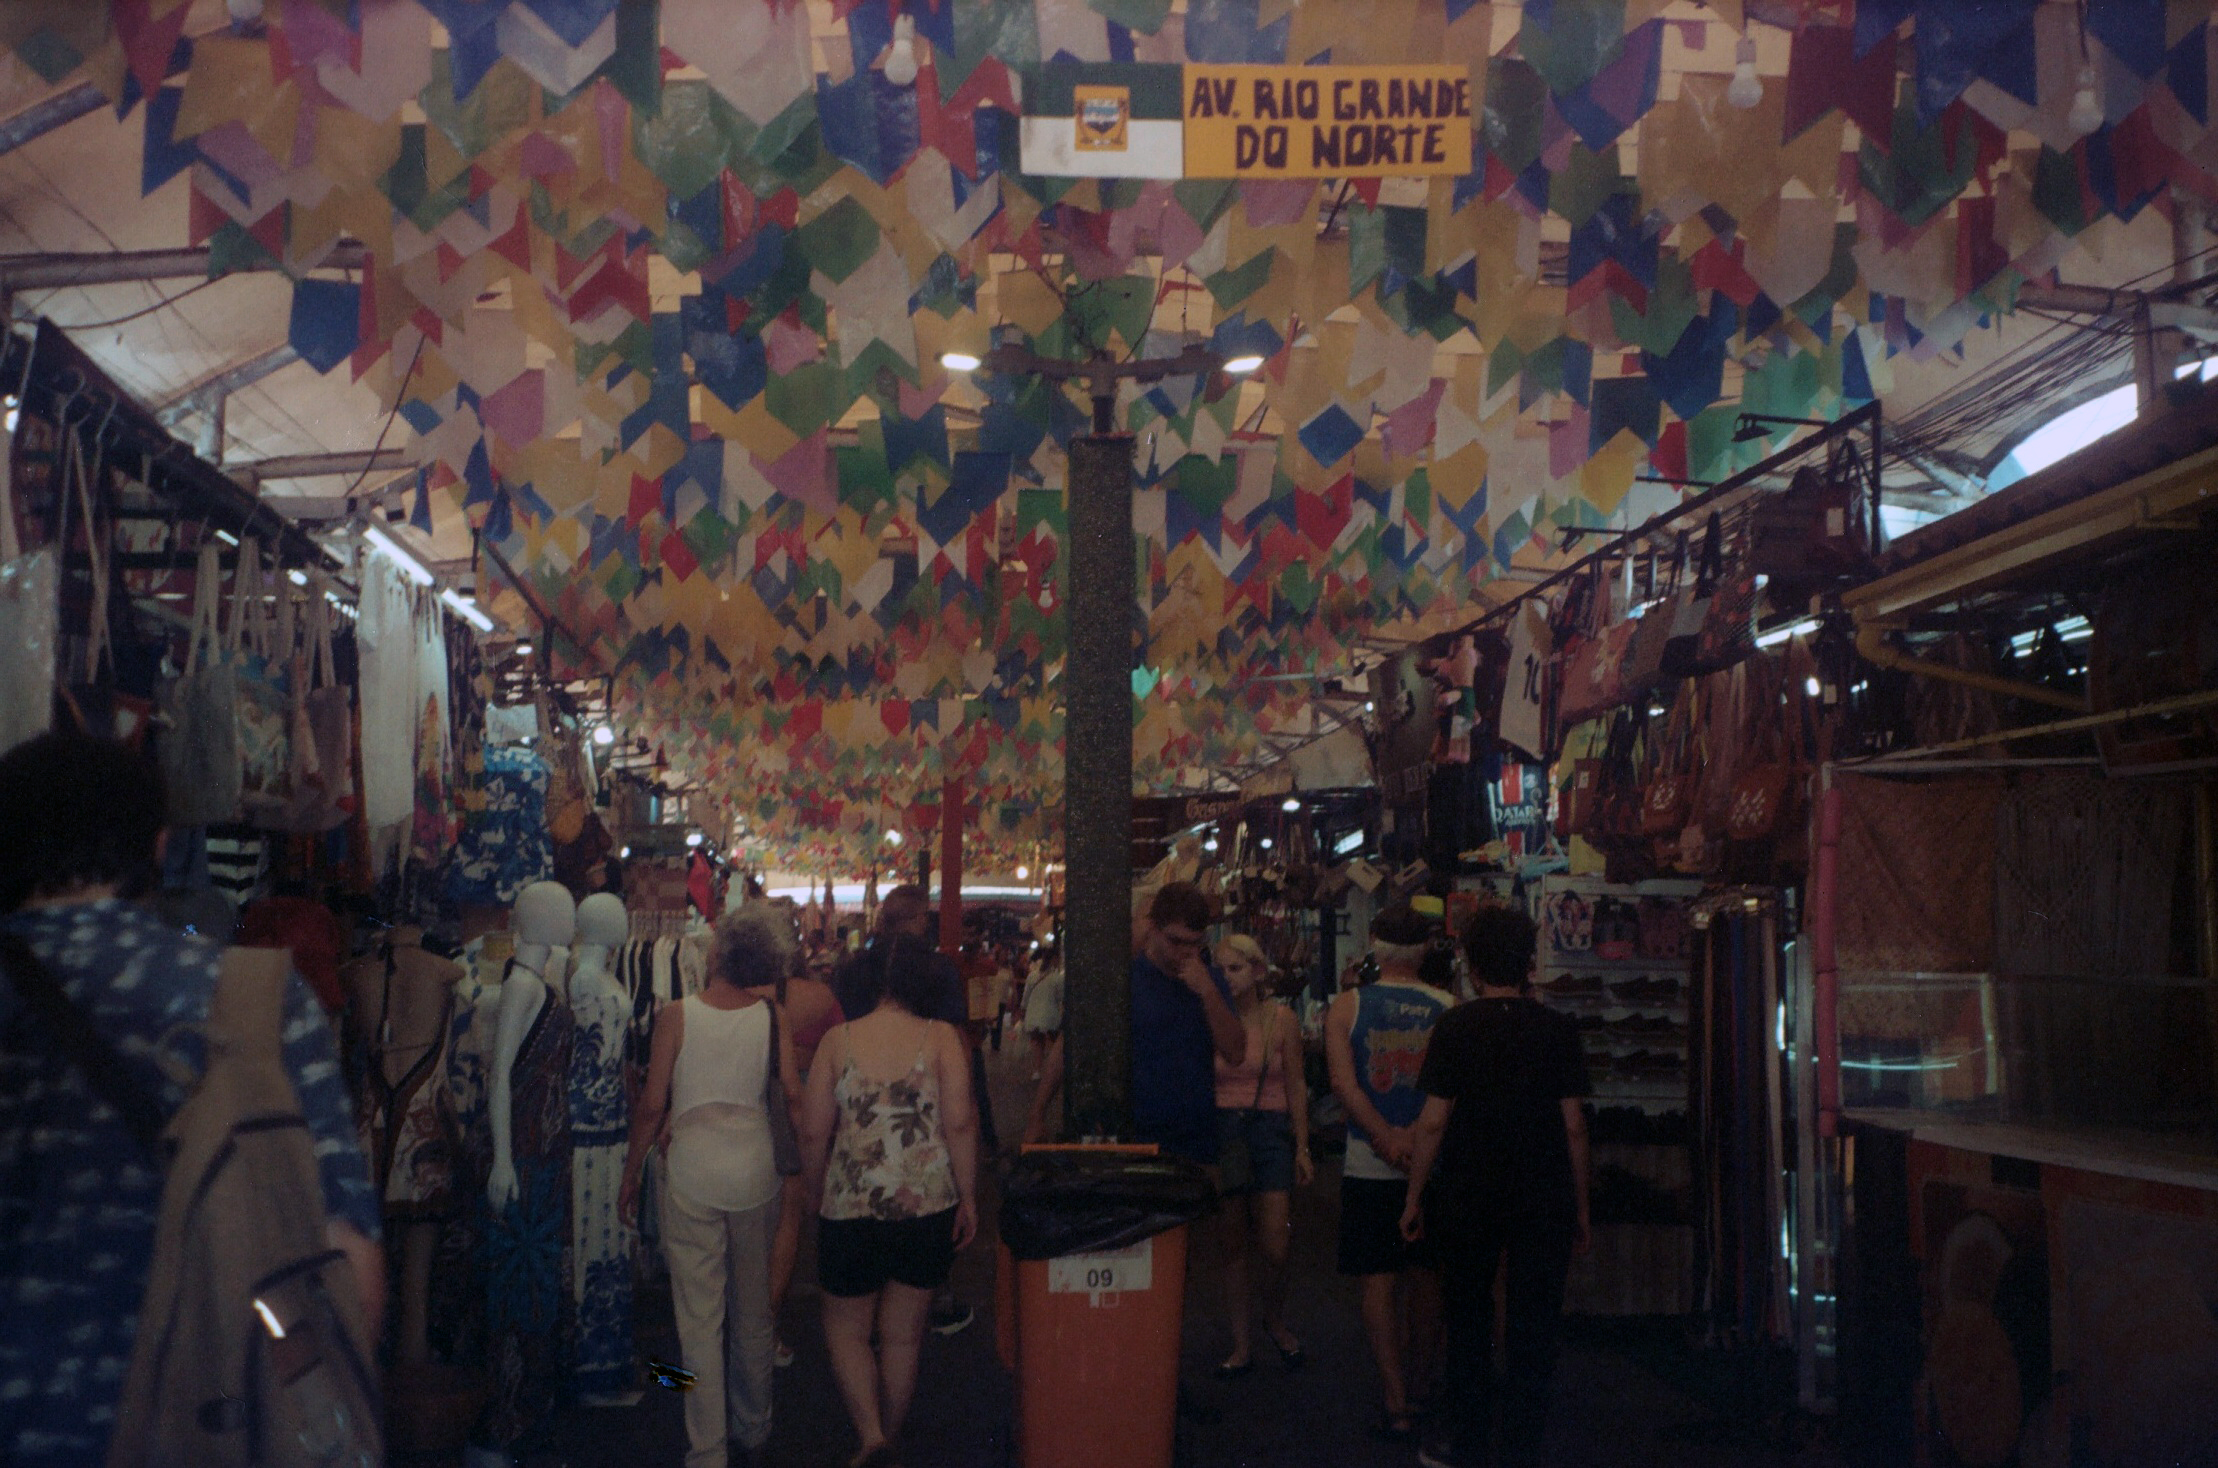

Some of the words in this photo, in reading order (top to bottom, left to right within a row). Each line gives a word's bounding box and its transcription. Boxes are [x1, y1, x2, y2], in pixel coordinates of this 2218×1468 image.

[1190, 78, 1240, 118] AV.
[1254, 79, 1319, 120] RIO
[1333, 78, 1470, 121] GRANDE
[1236, 126, 1288, 169] DO
[1312, 124, 1446, 168] NORTE
[1087, 1268, 1113, 1288] 09
